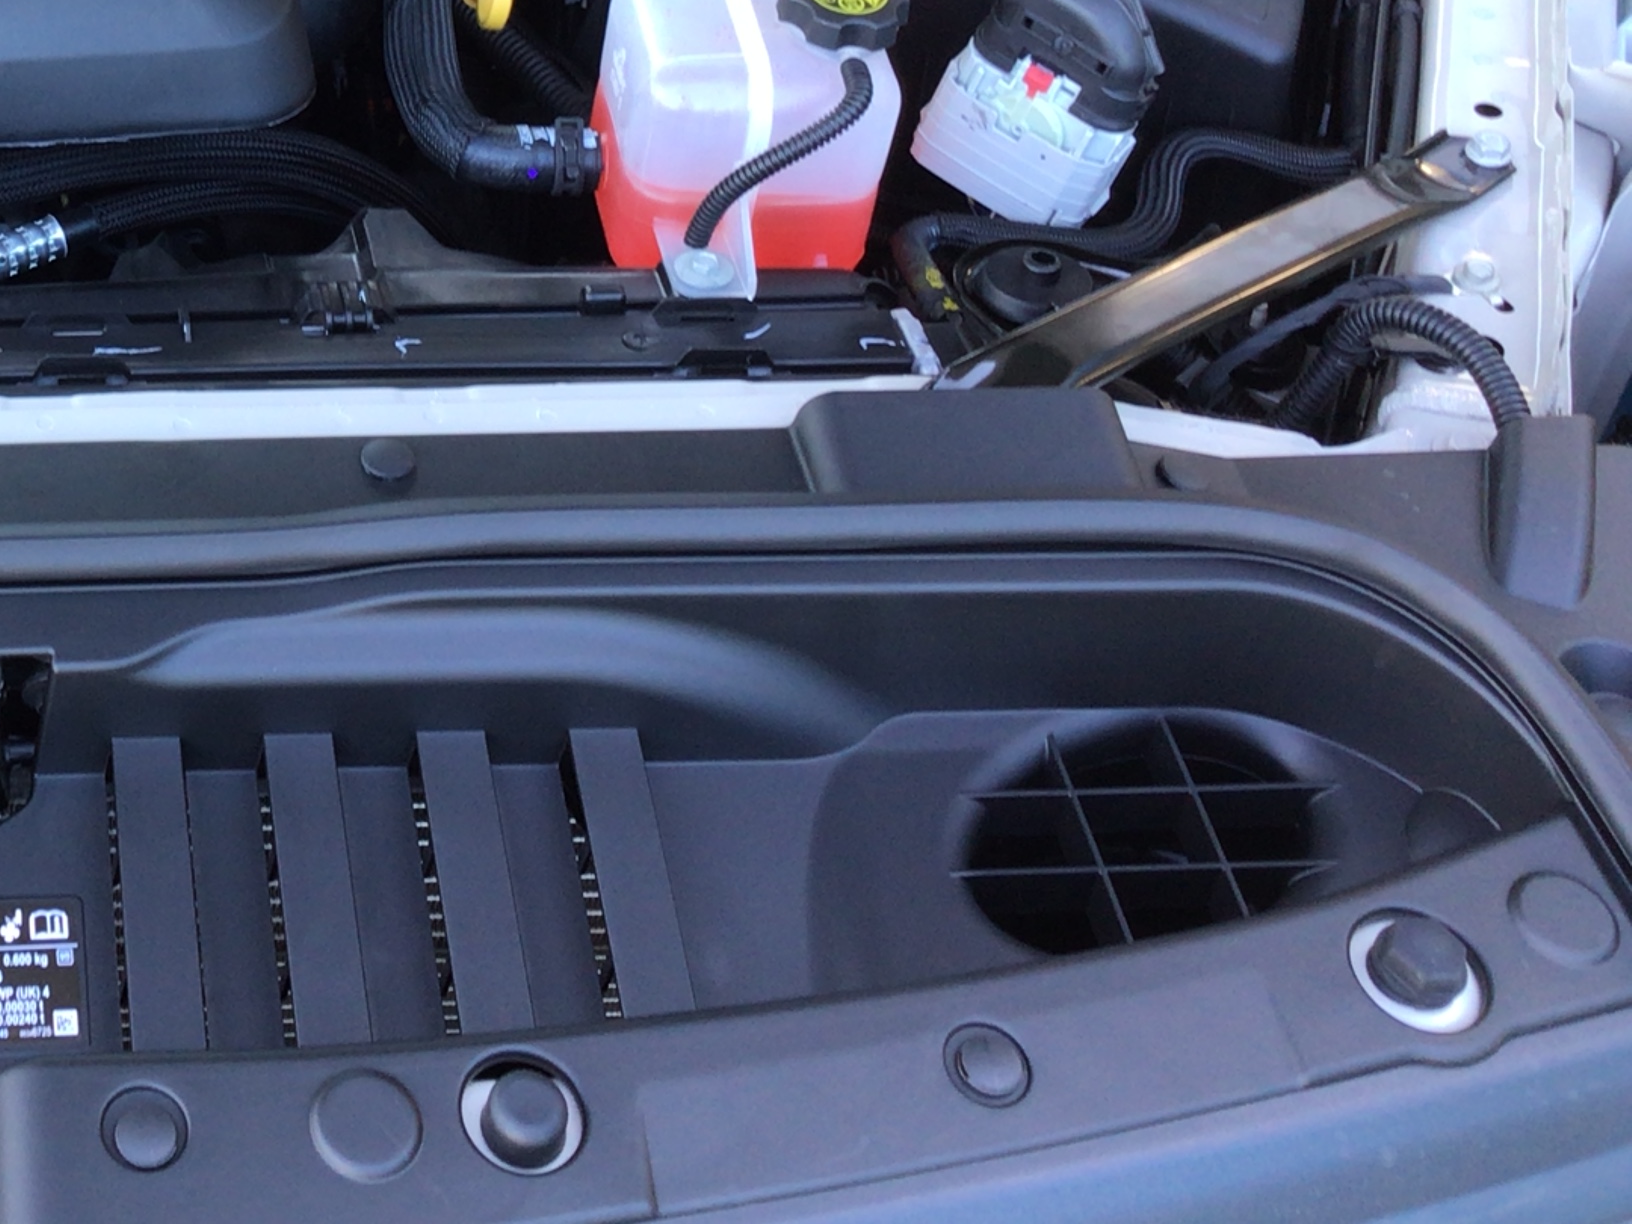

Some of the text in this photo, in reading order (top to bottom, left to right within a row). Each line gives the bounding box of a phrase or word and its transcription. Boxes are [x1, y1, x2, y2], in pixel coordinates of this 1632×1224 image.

[34, 951, 48, 968] kg
[16, 984, 40, 1001] (UK)
[42, 984, 50, 999] 4
